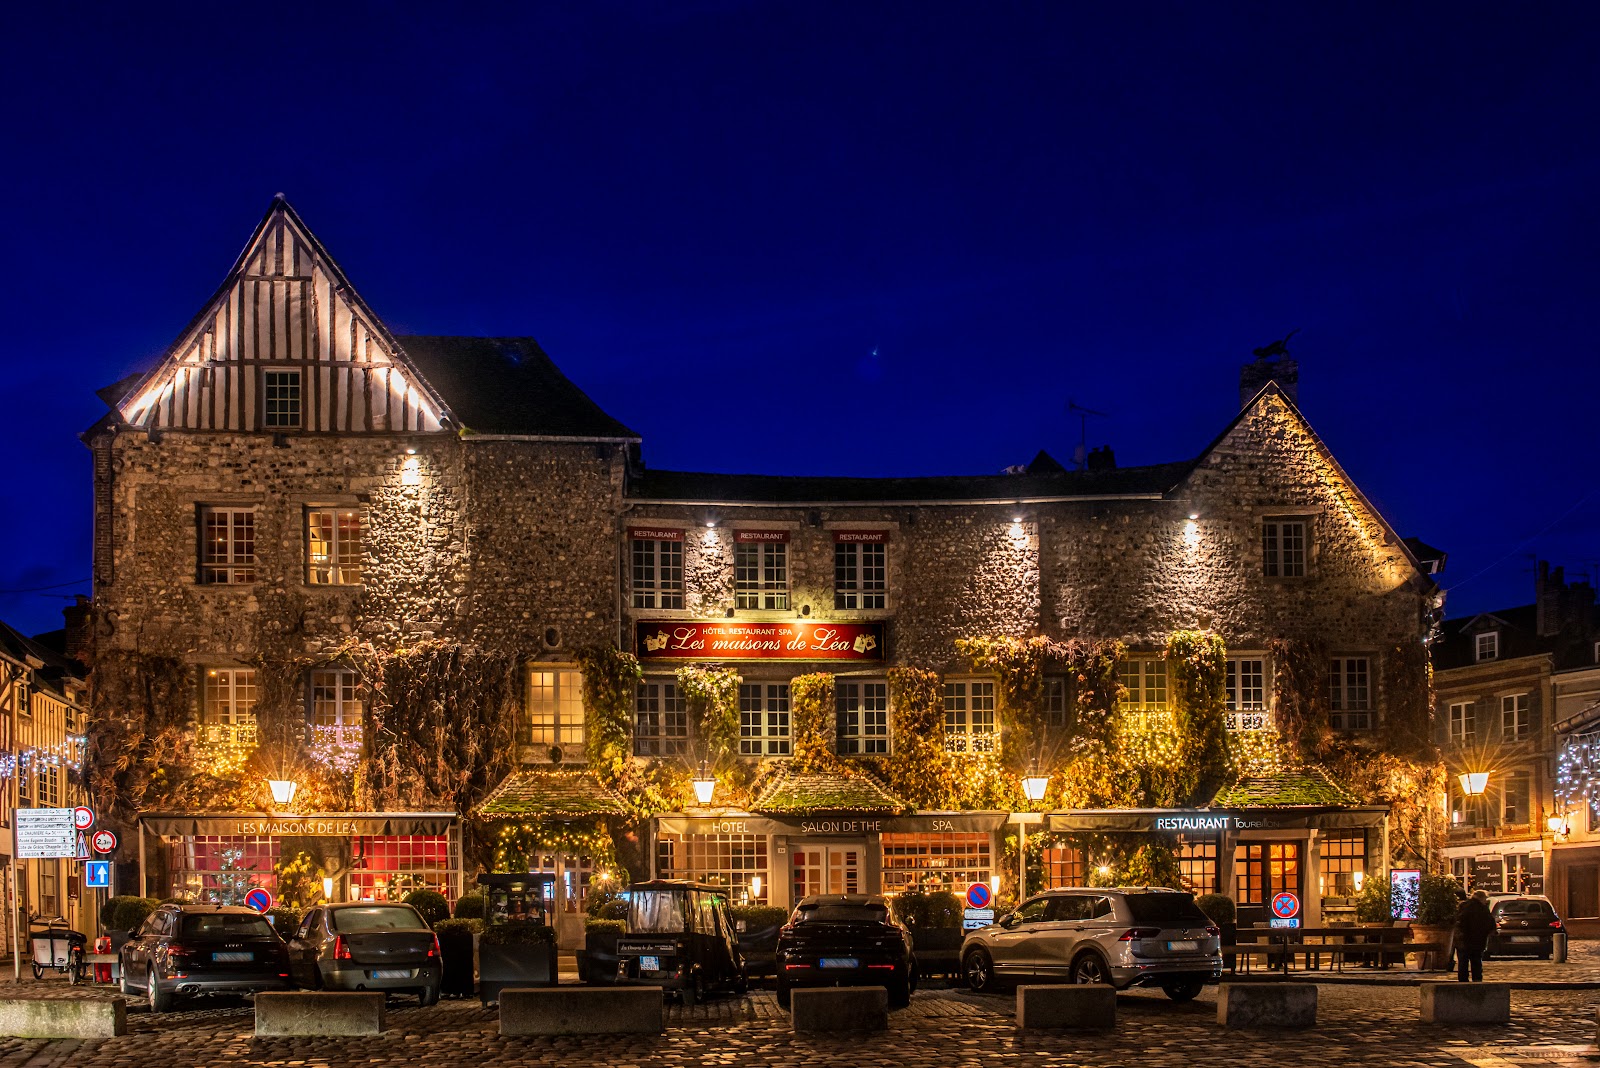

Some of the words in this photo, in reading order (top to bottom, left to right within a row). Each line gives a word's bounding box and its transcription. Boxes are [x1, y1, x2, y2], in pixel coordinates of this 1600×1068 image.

[634, 530, 678, 538] RESTAURANT
[702, 626, 726, 634] HÔTEL
[671, 628, 704, 650] Les
[712, 636, 780, 650] maisons
[786, 632, 806, 650] de
[810, 628, 850, 650] Léa
[237, 823, 256, 833] LES
[260, 823, 314, 833] MAISONS
[318, 823, 333, 833] DE
[336, 822, 358, 834] LEA
[712, 822, 749, 832] HOTEL
[801, 822, 840, 832] SALON
[842, 822, 858, 832] DE
[860, 821, 881, 831] THE
[932, 820, 954, 831] SPA
[1157, 818, 1229, 829] RESTAURANT
